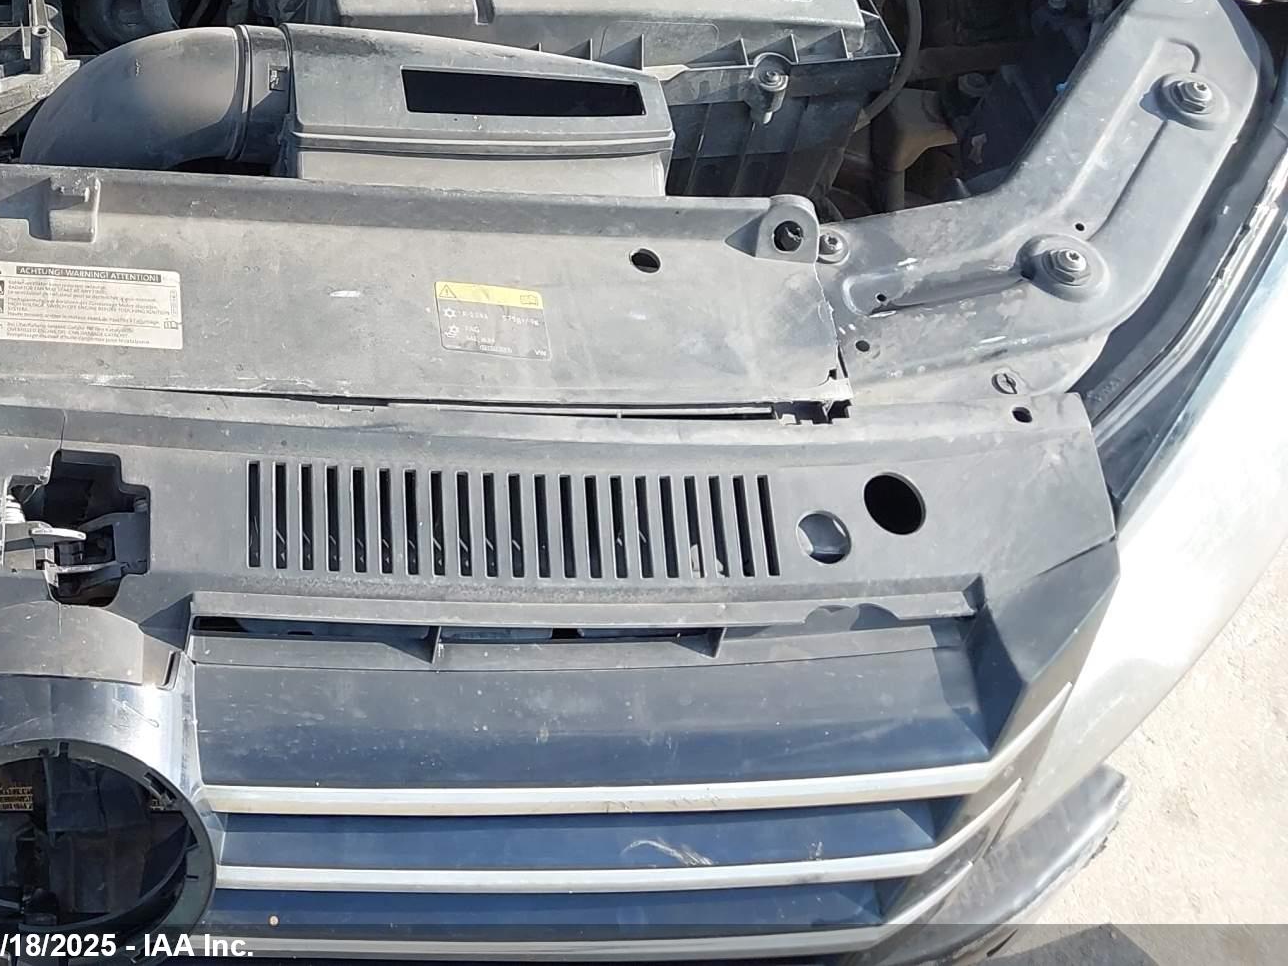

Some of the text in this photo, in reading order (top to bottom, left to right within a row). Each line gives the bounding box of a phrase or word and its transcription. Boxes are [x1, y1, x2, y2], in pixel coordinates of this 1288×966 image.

[20, 266, 159, 282] ACHTUNG! WARNING! ATTENTION!
